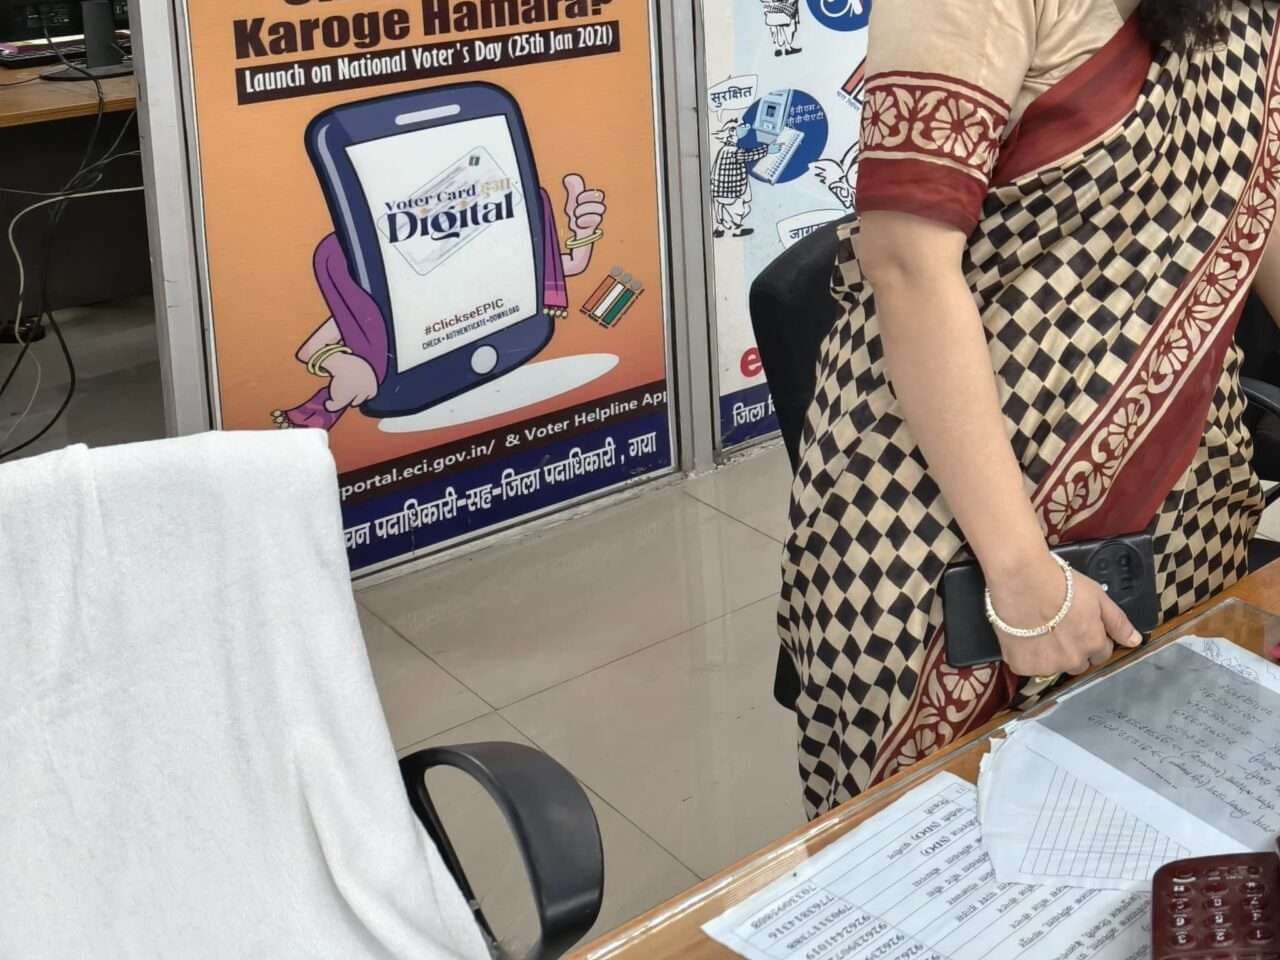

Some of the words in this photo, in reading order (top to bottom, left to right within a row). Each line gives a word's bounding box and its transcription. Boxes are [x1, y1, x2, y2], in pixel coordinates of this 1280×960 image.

[232, 5, 411, 60] Karoge
[244, 65, 305, 93] Launch
[311, 64, 332, 83] on
[337, 54, 407, 81] National
[412, 46, 470, 71] Voter's
[475, 39, 502, 63] Day
[507, 31, 545, 60] (25th
[549, 29, 574, 53] Jan
[577, 25, 613, 49] 2021)
[711, 85, 753, 109] सुरक्षित
[385, 193, 434, 212] Voter
[437, 187, 477, 204] Card
[385, 191, 515, 243] Digital
[422, 336, 442, 351] CHECK
[445, 318, 487, 341] AUTHENTICATE
[490, 305, 520, 326] DOWNLOAD
[424, 298, 505, 336] #ClickseEPIC
[505, 433, 520, 447] &
[524, 416, 569, 439] Voter
[575, 399, 638, 428] Helpline
[733, 401, 765, 426] जिला
[544, 437, 616, 486] पदाधिकारी
[628, 431, 657, 456] गया
